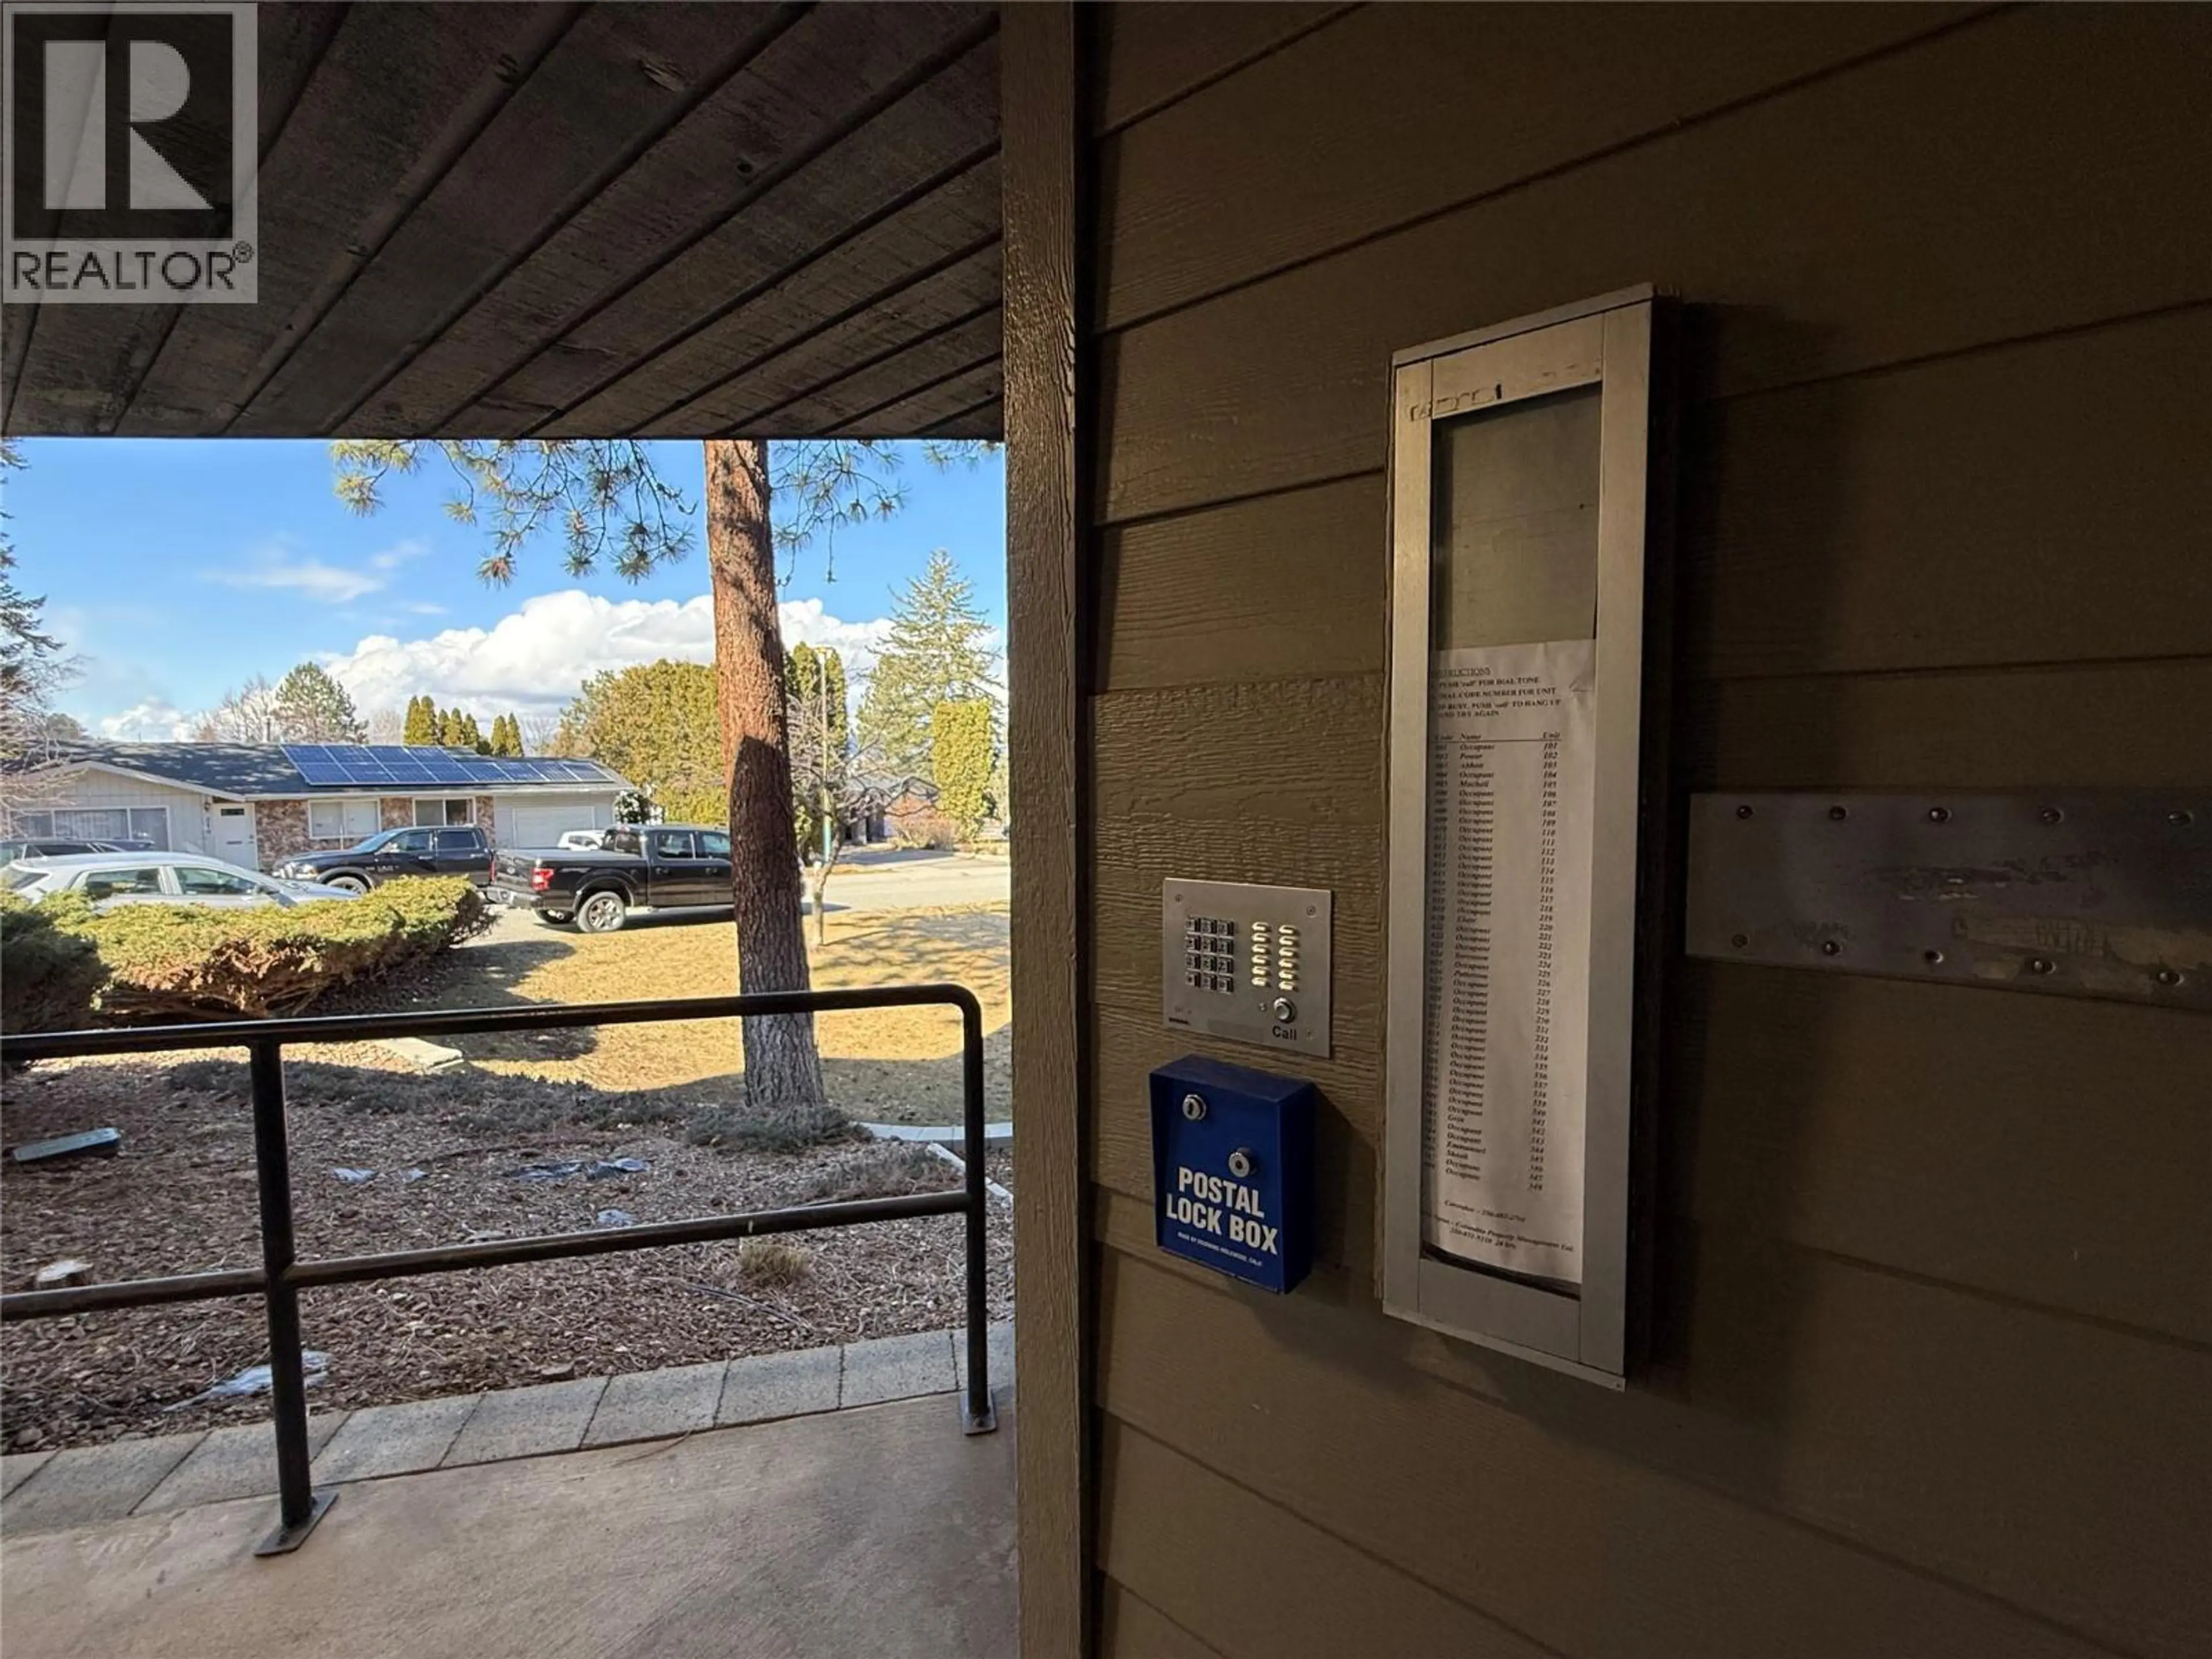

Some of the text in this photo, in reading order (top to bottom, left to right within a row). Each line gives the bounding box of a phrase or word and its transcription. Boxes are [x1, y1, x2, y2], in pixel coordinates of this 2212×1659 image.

[1517, 676, 1539, 684] TONE
[1536, 687, 1557, 695] UNIT
[1474, 709, 1499, 717] AGAIN
[1459, 732, 1482, 740] Name
[1272, 1025, 1297, 1041] Call
[1178, 1166, 1265, 1219] POSTAL
[1166, 1192, 1279, 1255] LOCK BOX
